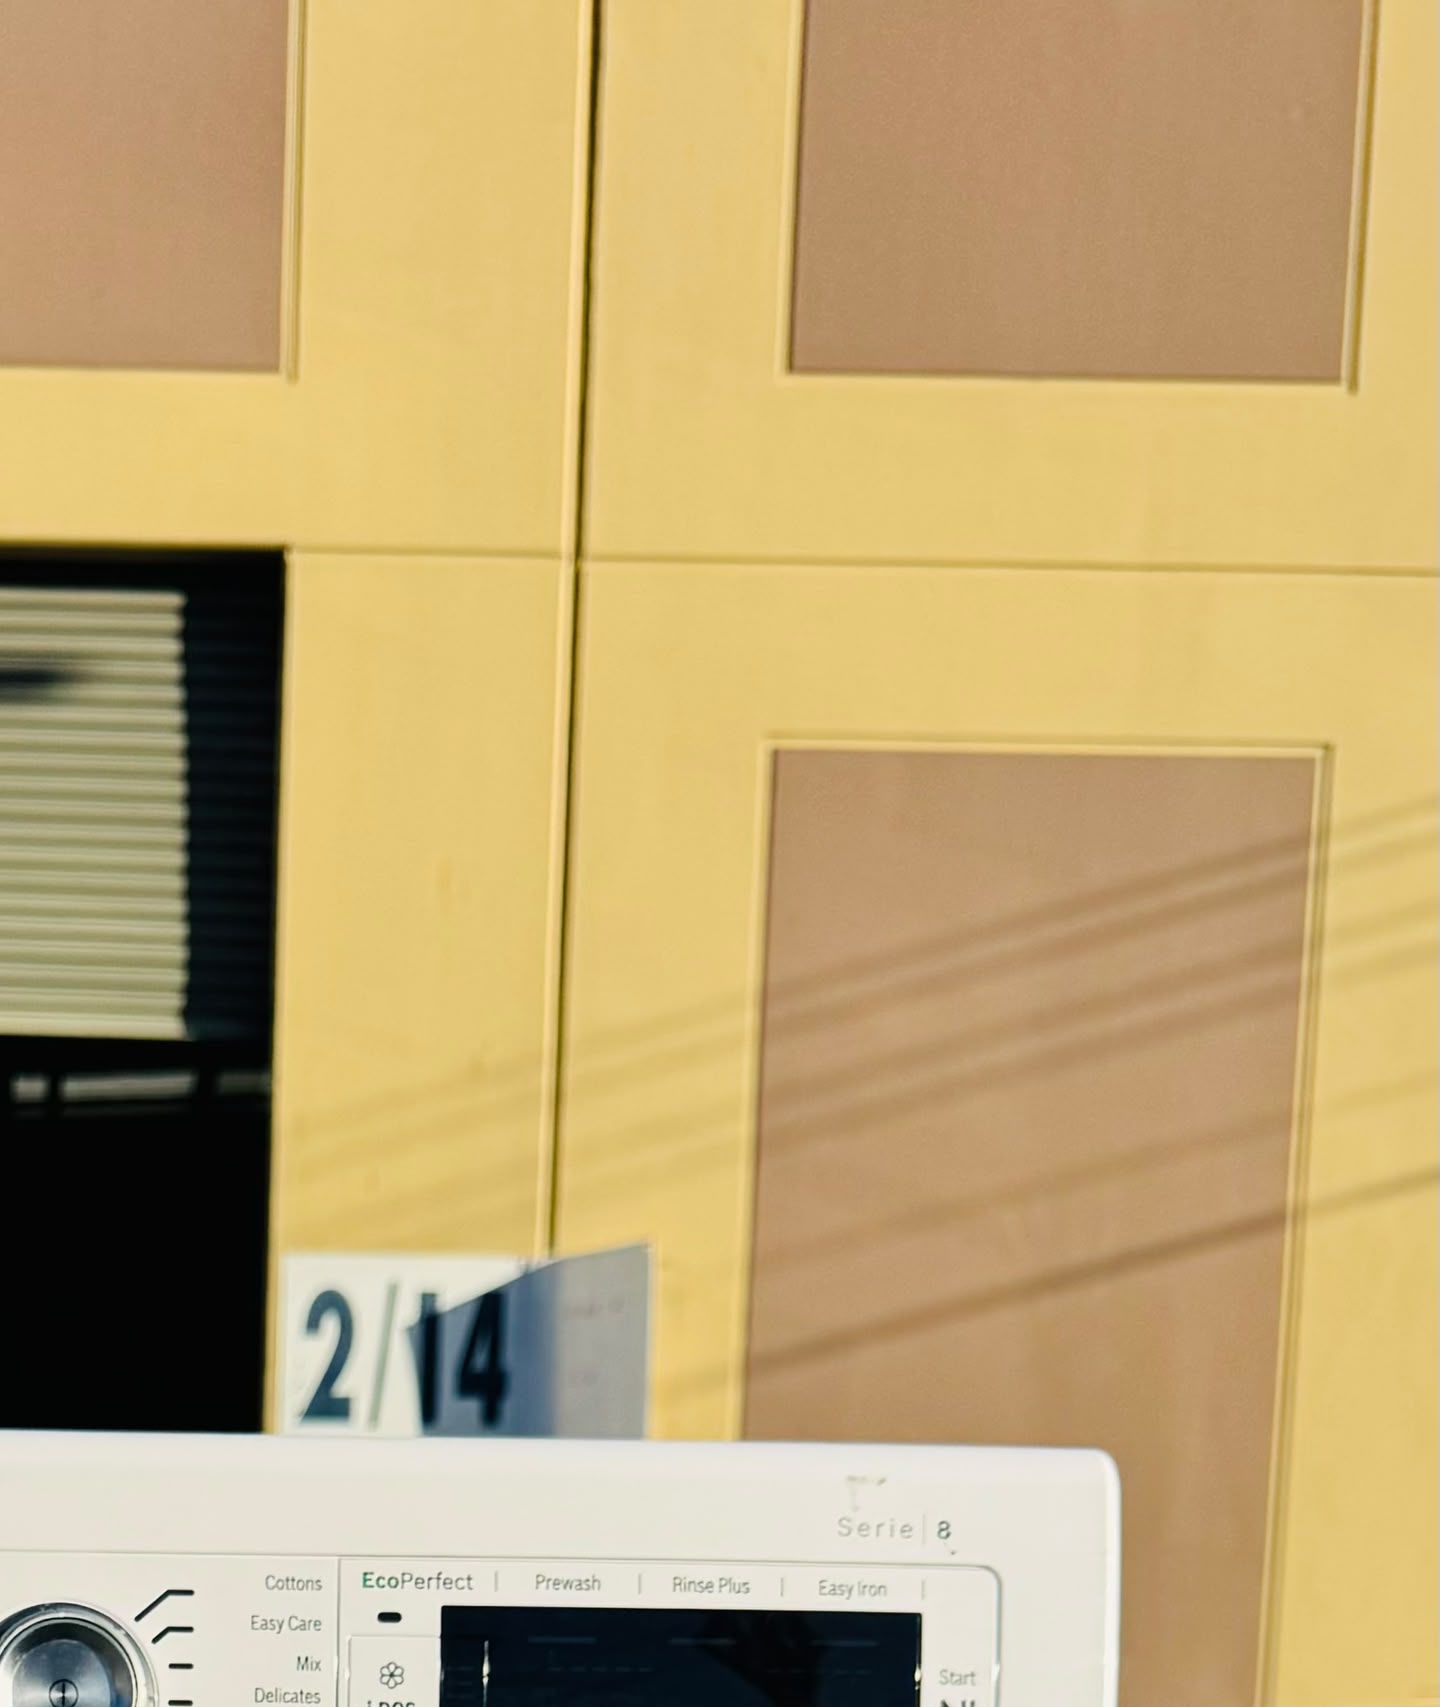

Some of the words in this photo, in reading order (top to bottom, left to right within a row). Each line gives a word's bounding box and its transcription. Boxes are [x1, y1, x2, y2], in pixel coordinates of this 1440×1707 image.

[299, 1283, 509, 1428] 2/14
[836, 1516, 914, 1540] Serie
[936, 1520, 952, 1540] 8
[264, 1574, 323, 1592] Cottons
[361, 1570, 474, 1592] EcoPerfect
[534, 1573, 601, 1593] Prewash
[671, 1576, 714, 1595] Rinse
[717, 1576, 750, 1596] Plus
[818, 1579, 854, 1600] Easy
[857, 1580, 888, 1597] Iron
[250, 1616, 284, 1634] Easy
[287, 1616, 322, 1632] Care
[295, 1656, 322, 1673] Mix
[938, 1667, 977, 1687] Start
[253, 1687, 322, 1704] Delicates
